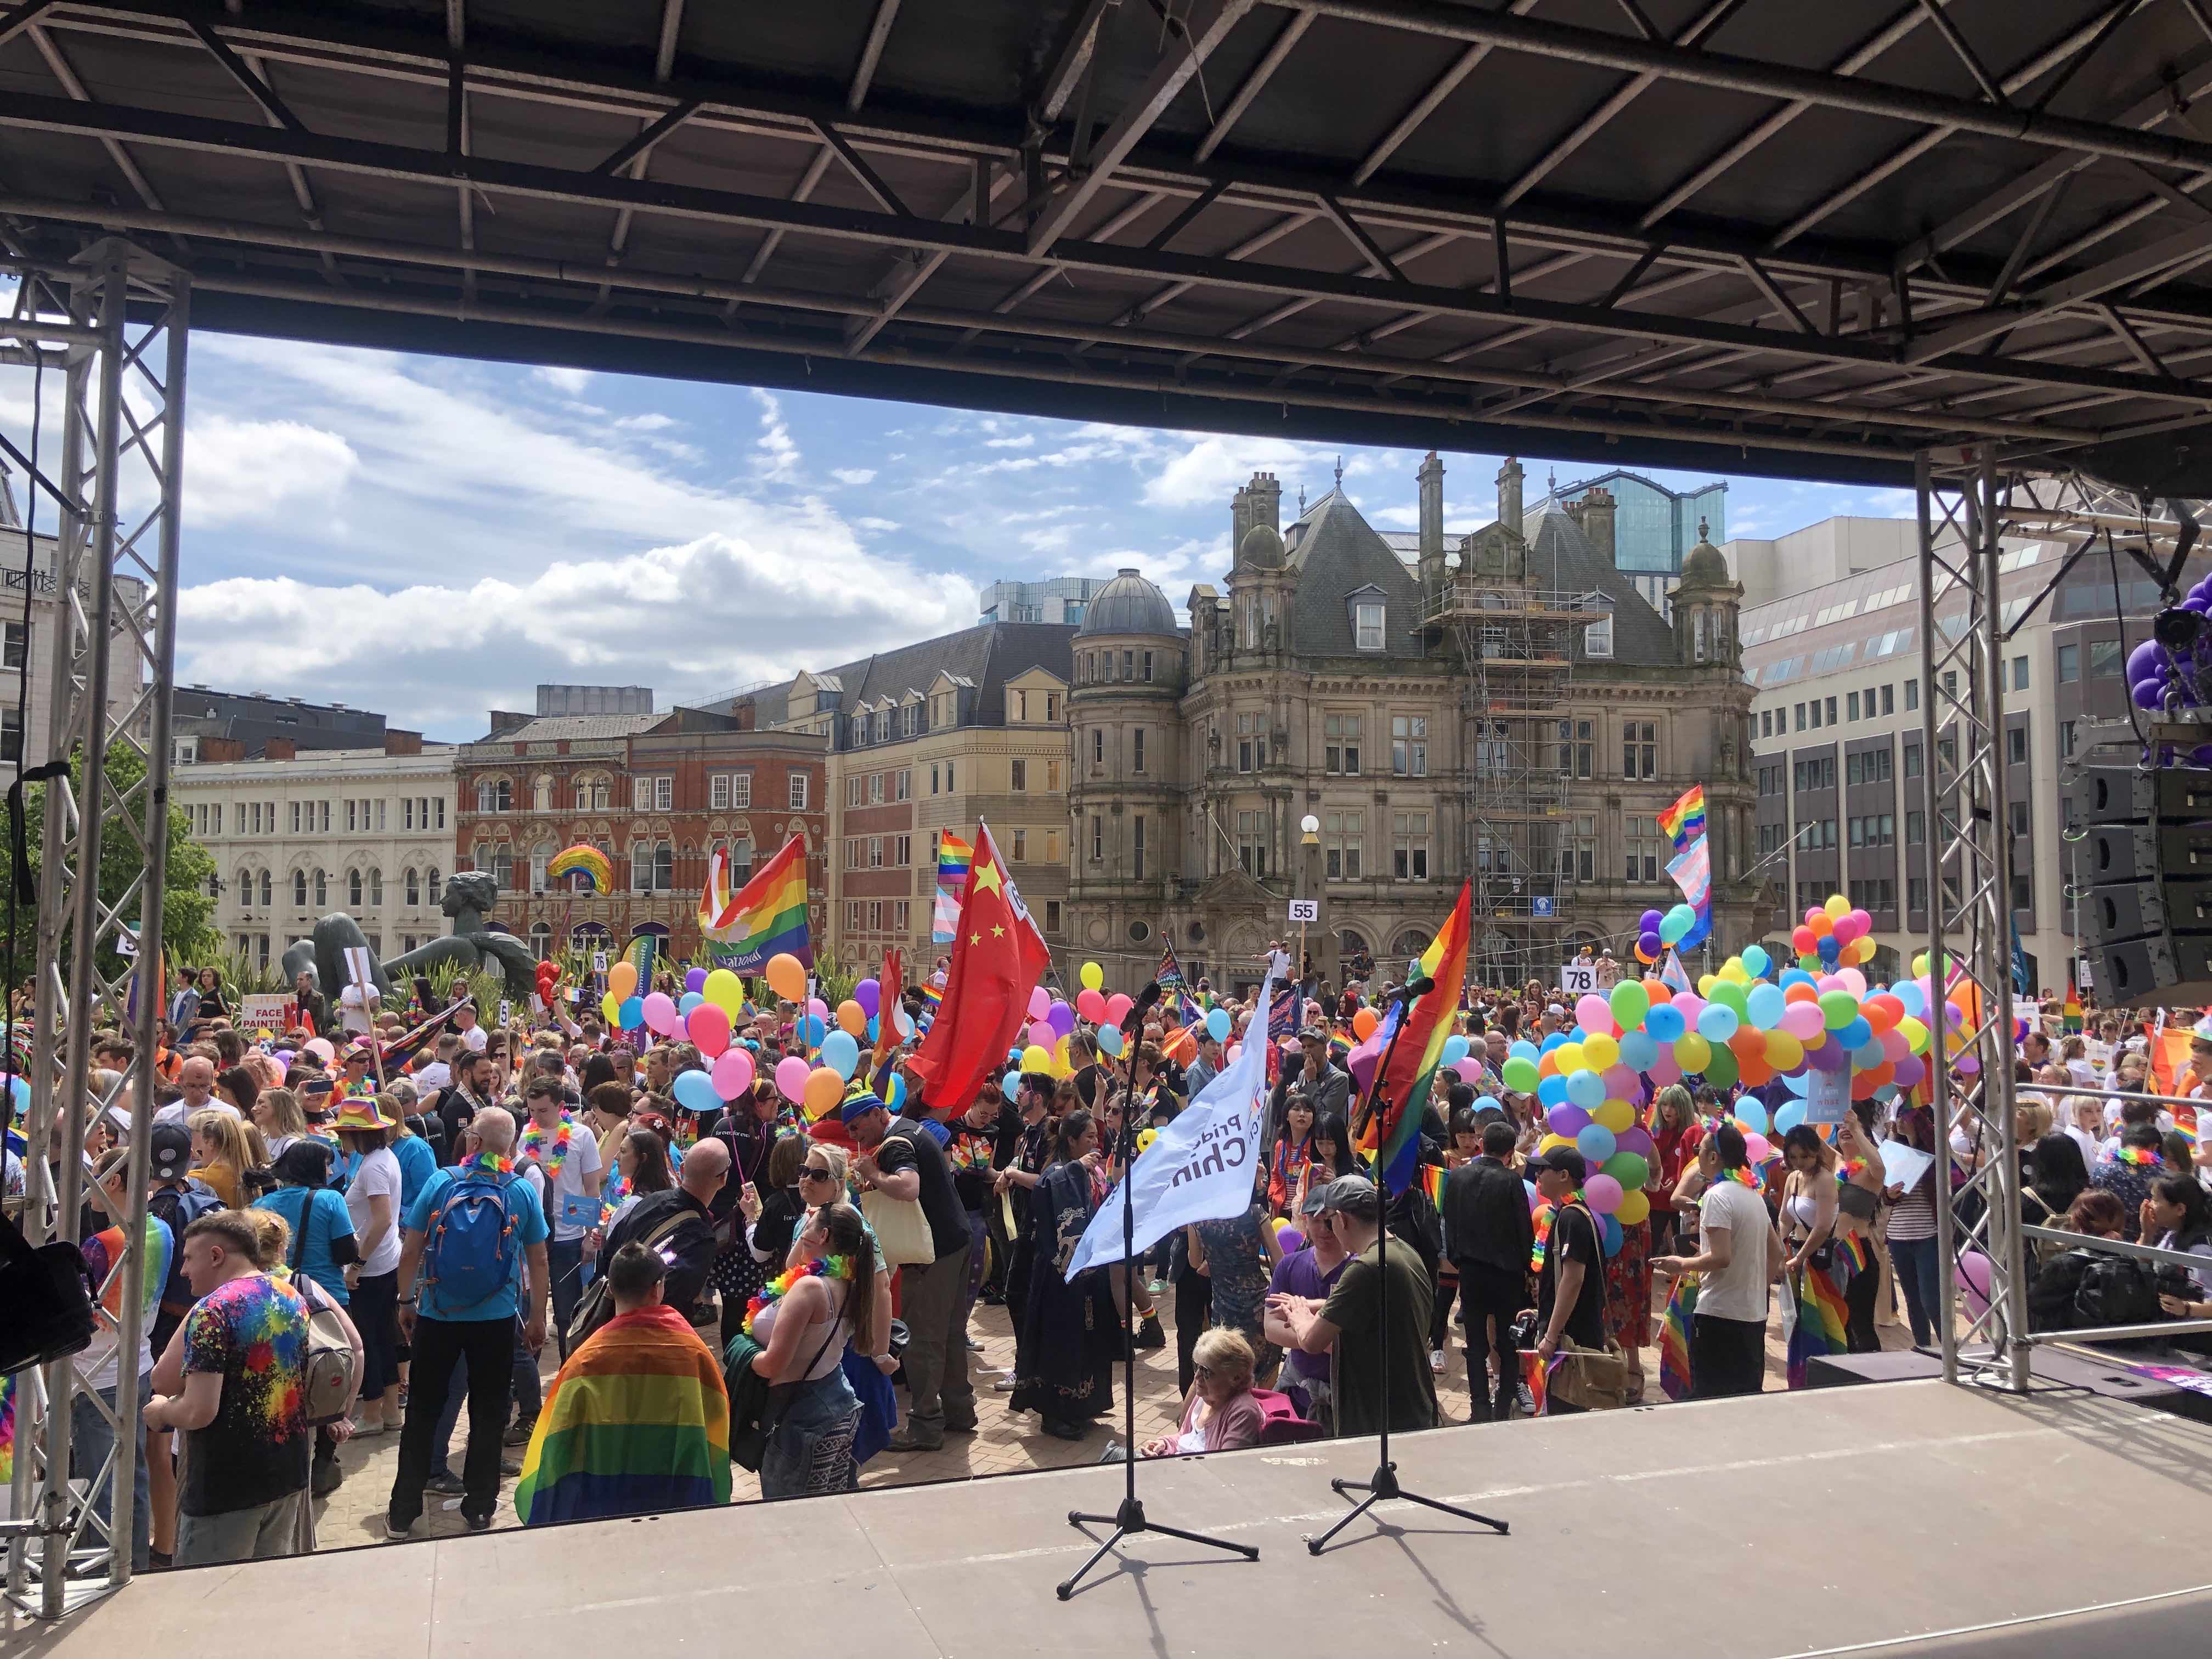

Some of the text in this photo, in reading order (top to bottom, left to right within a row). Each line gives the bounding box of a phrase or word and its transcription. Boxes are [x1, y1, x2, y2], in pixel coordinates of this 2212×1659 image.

[1294, 904, 1313, 918] 55
[595, 956, 604, 969] 76
[638, 942, 648, 996] ommunity
[1567, 971, 1591, 990] 78
[256, 1009, 283, 1017] FACE
[501, 1005, 507, 1023] 5
